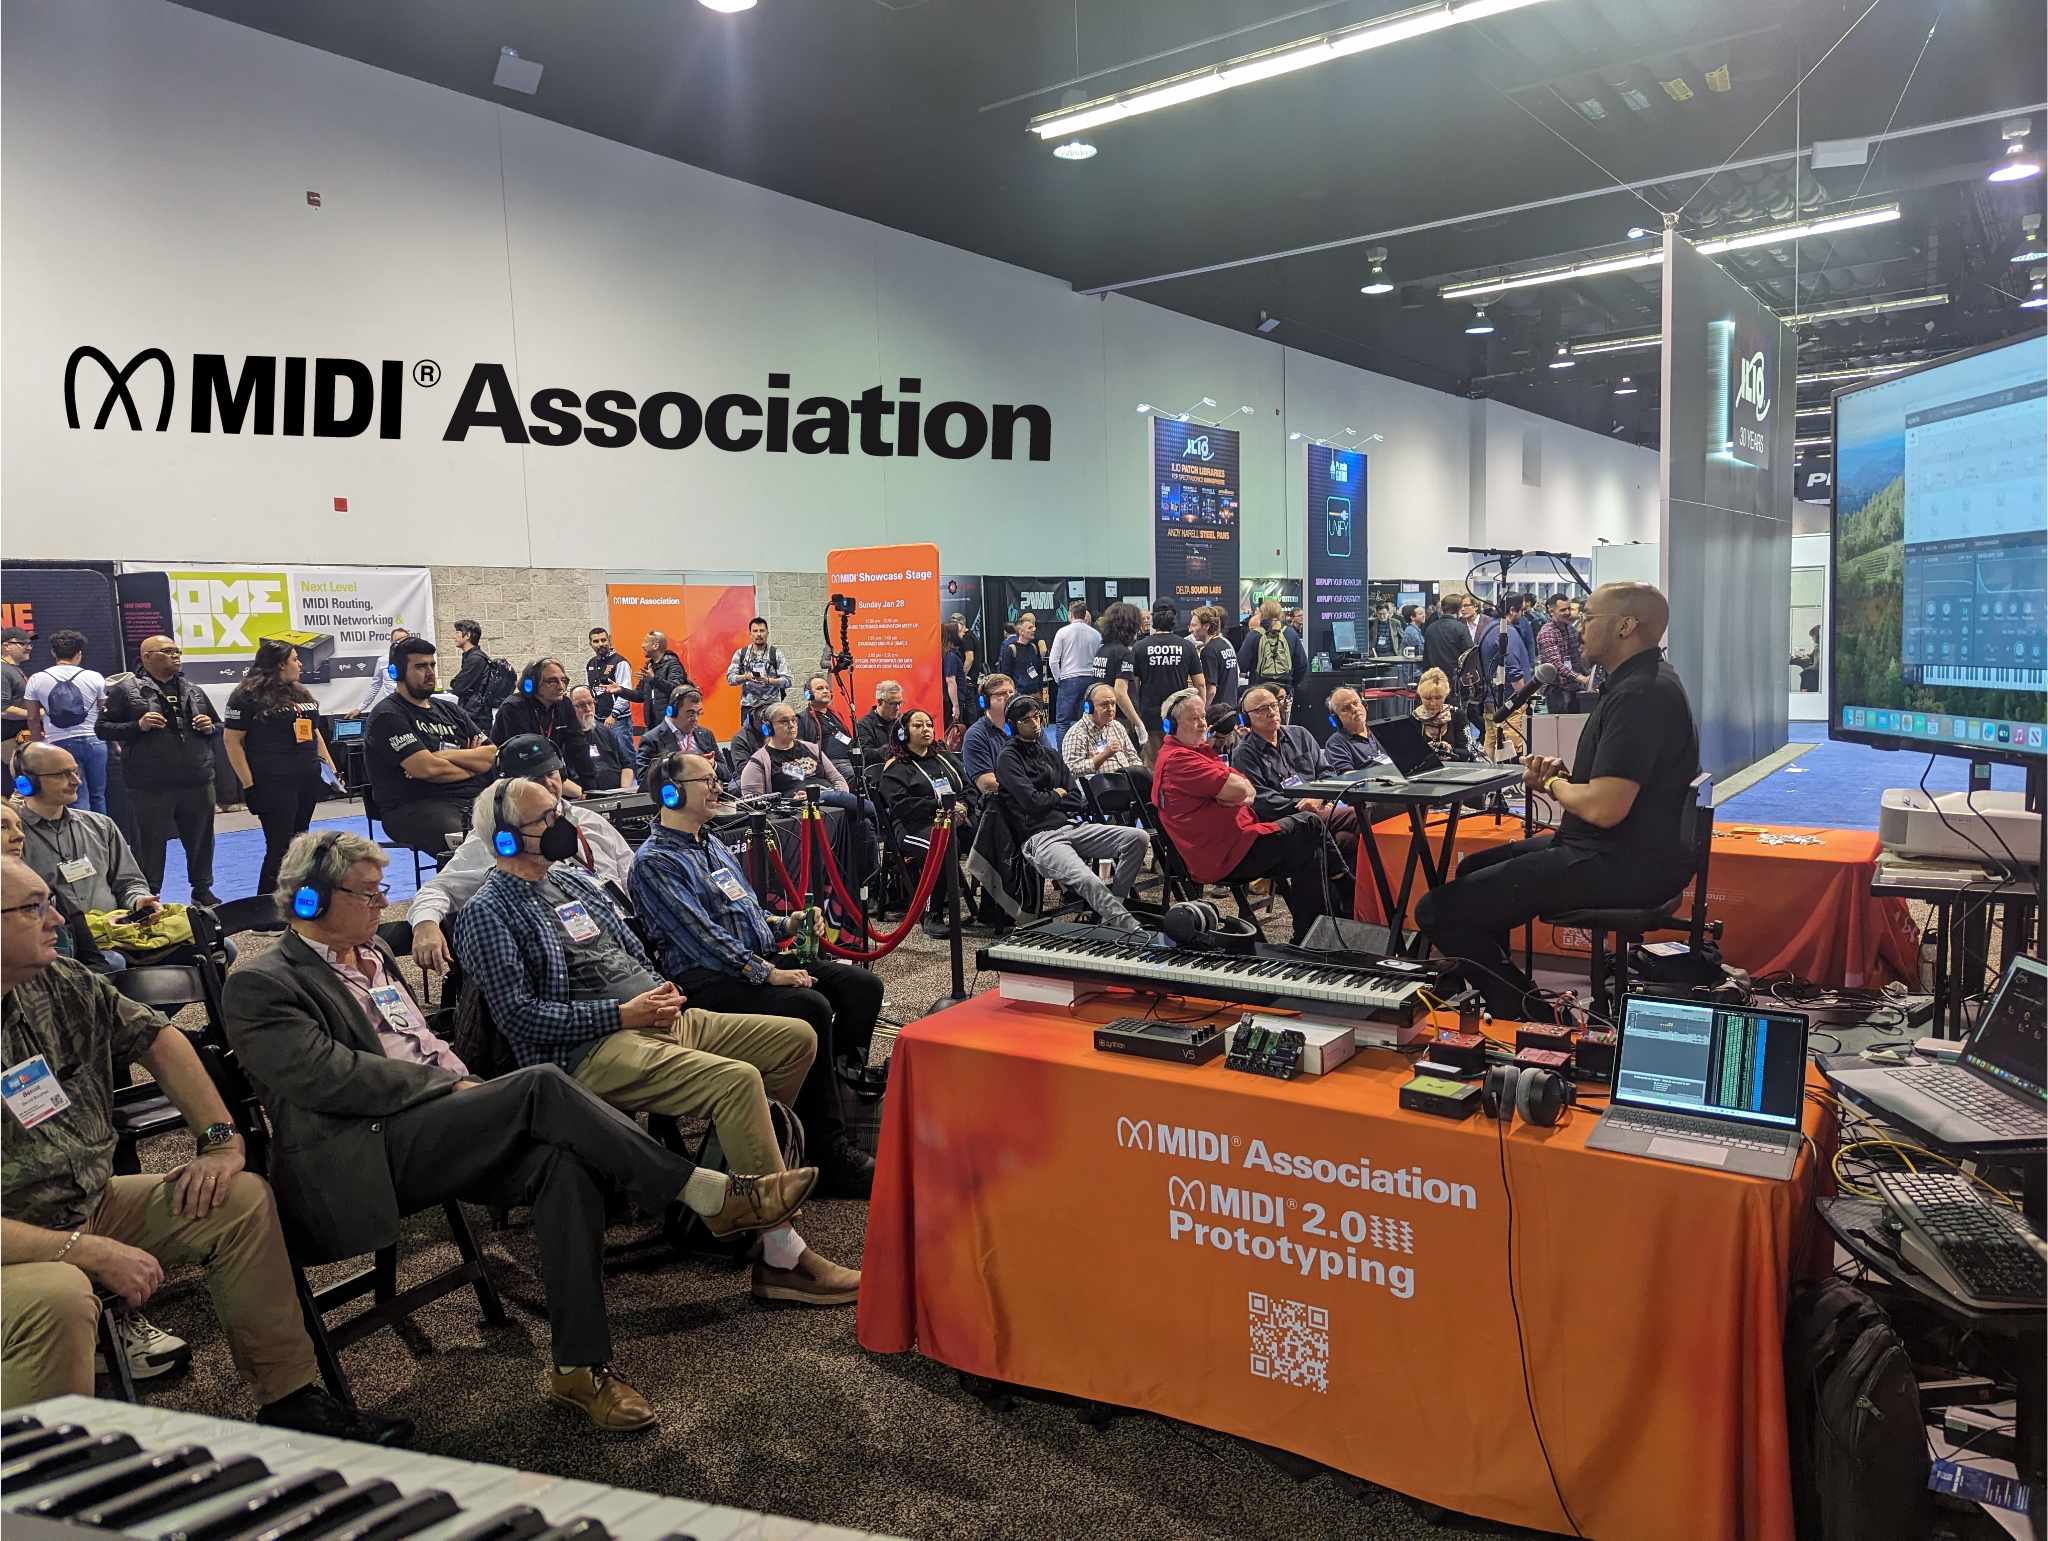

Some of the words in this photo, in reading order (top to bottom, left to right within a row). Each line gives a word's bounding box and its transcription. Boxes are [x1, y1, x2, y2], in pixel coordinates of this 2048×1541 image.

[442, 362, 1052, 462] Association
[1739, 426, 1747, 448] 30
[1747, 430, 1764, 454] YEARS
[1181, 464, 1199, 475] PATCH
[1199, 467, 1226, 478] LIBRARIES
[1199, 530, 1216, 539] STEEL
[1216, 531, 1230, 540] PANS
[1328, 519, 1349, 537] UNIFY
[859, 572, 904, 582] Showcase
[905, 570, 932, 581] Stage
[301, 581, 327, 592] Next
[329, 580, 358, 593] Level
[1190, 586, 1209, 595] SOUND
[1209, 585, 1222, 595] LABS
[302, 597, 330, 609] MIDI
[331, 597, 374, 612] Routing,
[639, 596, 680, 606] Association
[858, 601, 882, 610] Sunday
[882, 600, 895, 608] Jan
[895, 599, 905, 608] 28
[303, 614, 331, 627] MIDI
[333, 613, 394, 628] Networking
[395, 613, 404, 625] &
[339, 630, 366, 643] MIDI
[1147, 645, 1183, 656] BOOTH
[1149, 655, 1182, 666] STAFF
[389, 732, 416, 749] NAMM
[1243, 1139, 1477, 1210] Association
[1301, 1202, 1367, 1244] 2.0
[1169, 1209, 1415, 1299] Prototyping
